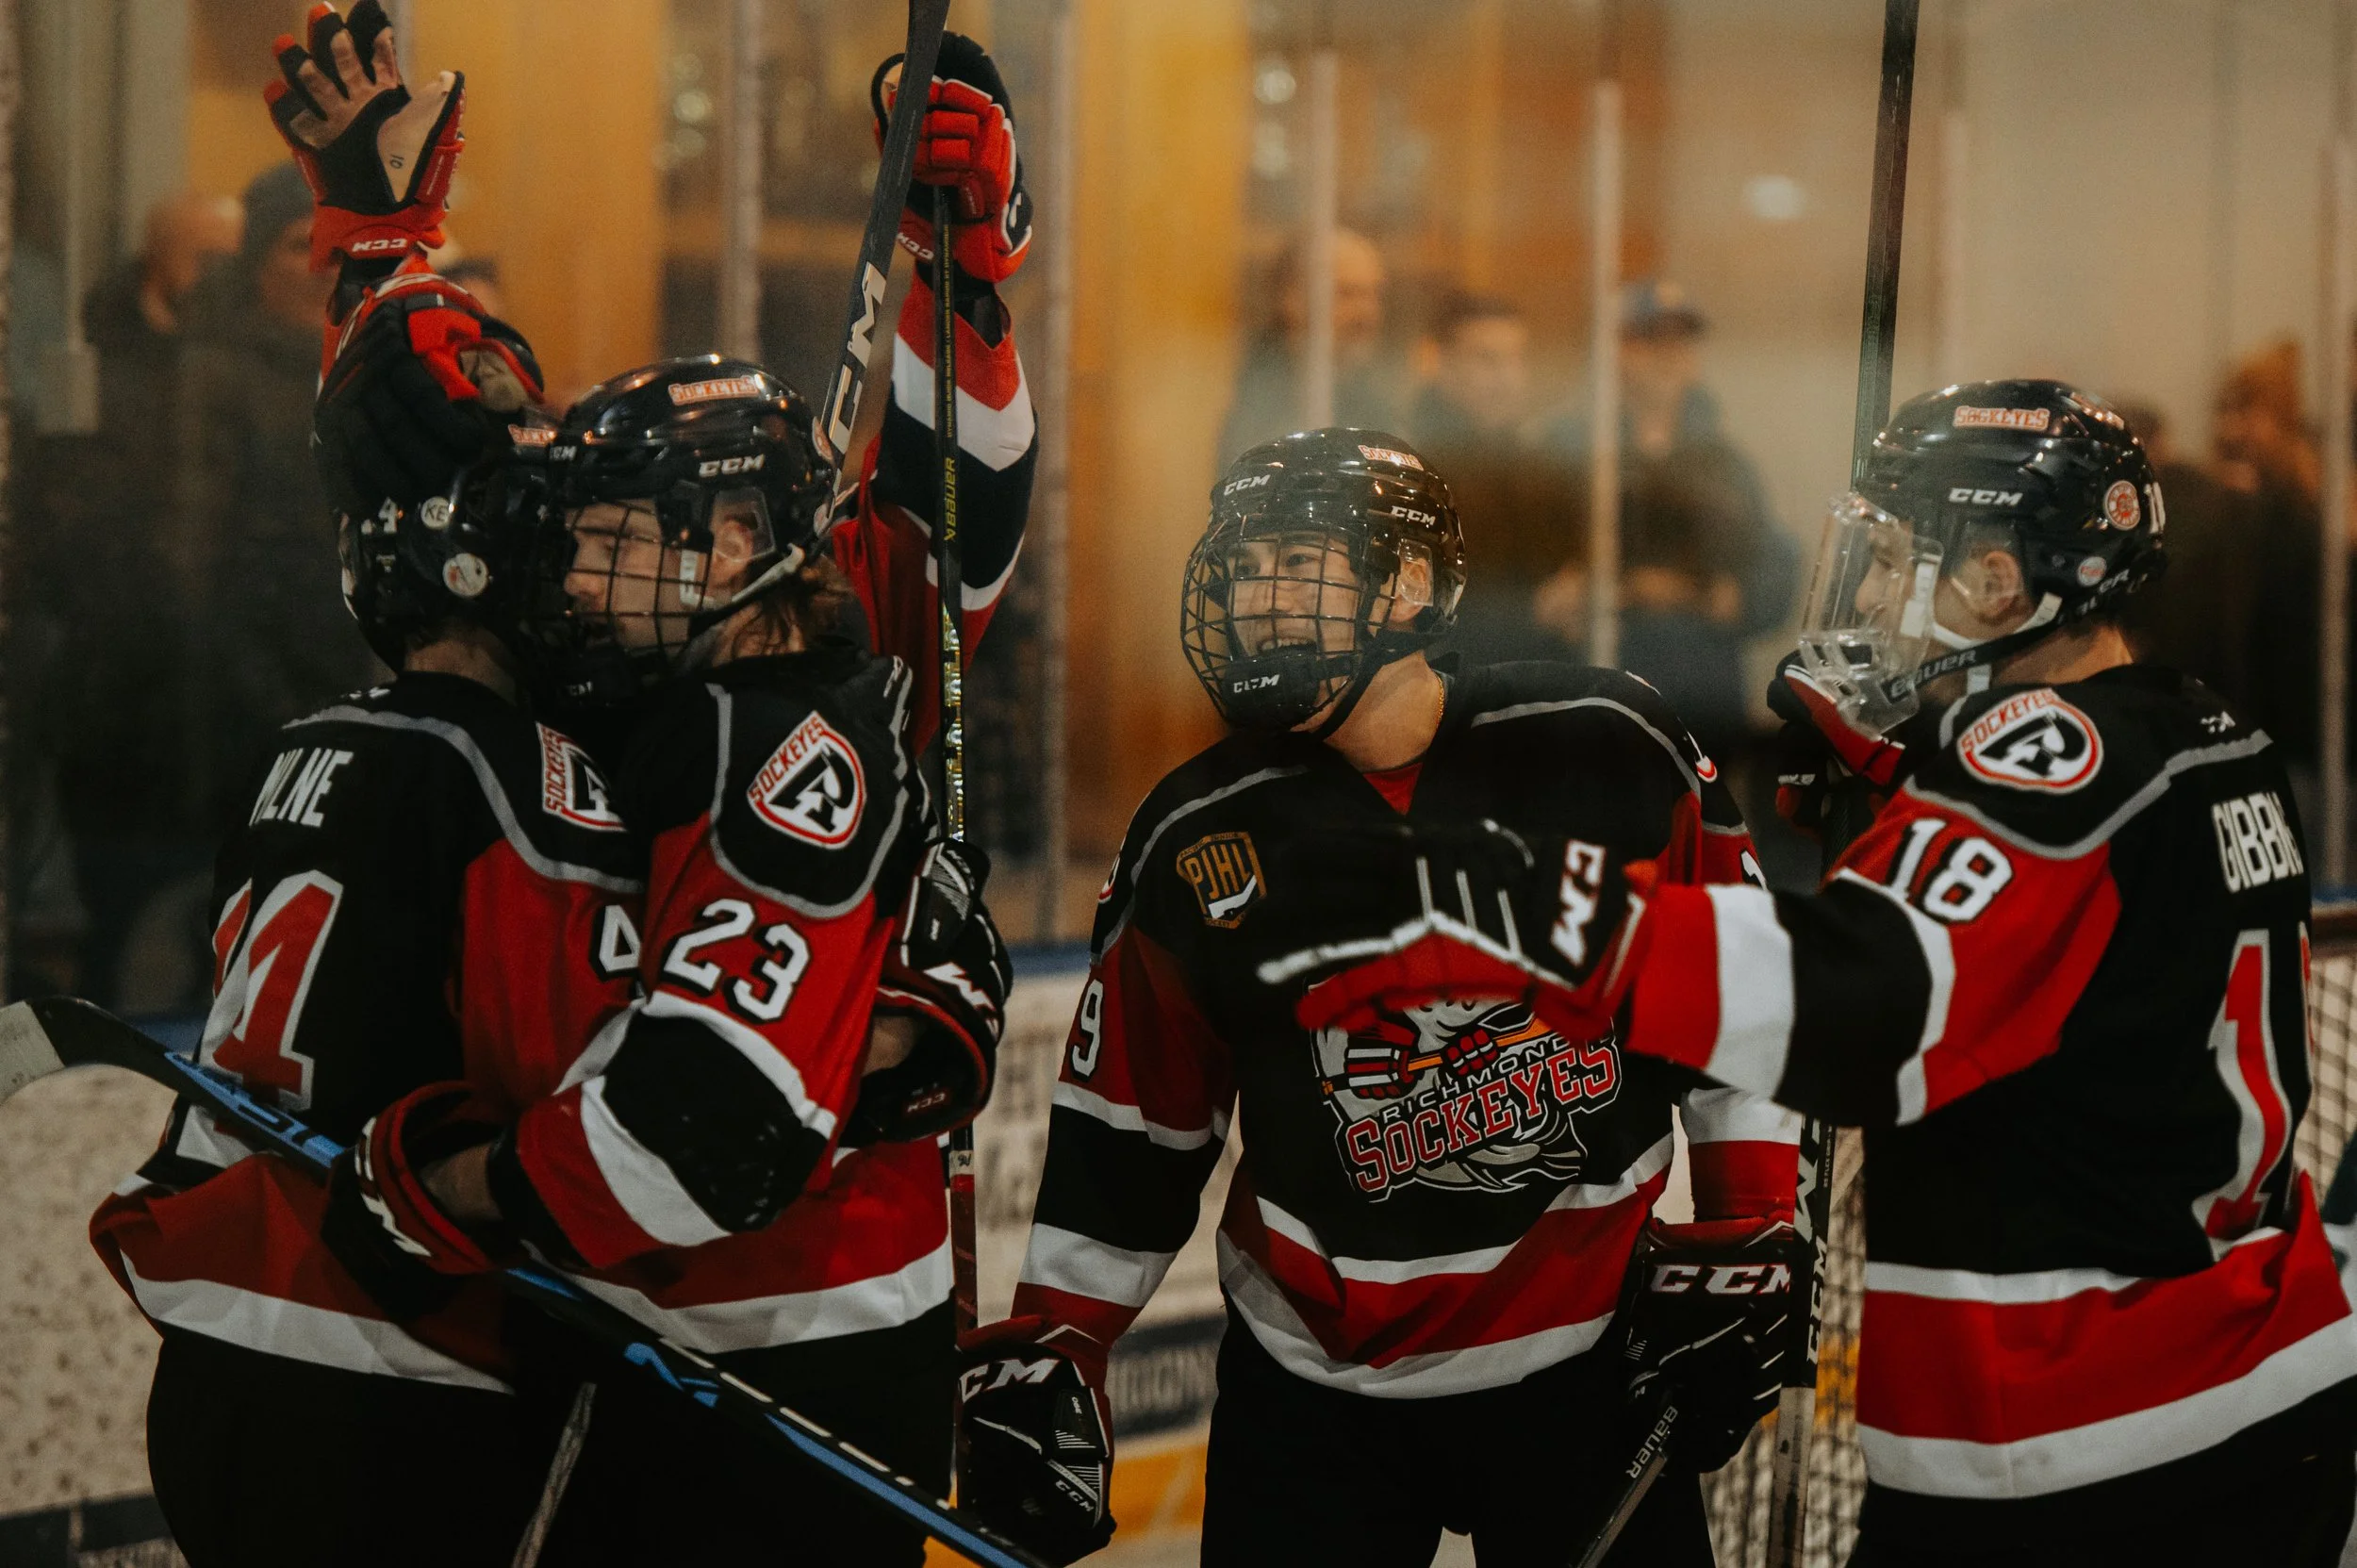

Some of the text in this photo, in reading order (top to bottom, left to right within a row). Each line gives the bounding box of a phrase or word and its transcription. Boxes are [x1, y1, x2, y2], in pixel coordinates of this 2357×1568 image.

[352, 239, 408, 253] CCM
[670, 377, 760, 405] SOCKEYES
[1954, 405, 2050, 431] SOCKEYES
[699, 454, 766, 478] CCM
[944, 457, 956, 527] BAUER
[1224, 475, 1271, 496] CCM
[1949, 487, 2023, 506] CCM
[1391, 505, 1437, 526] CCM
[1961, 688, 2059, 754] SOCKEYES
[544, 726, 568, 813] SOCKEYES
[749, 715, 826, 803] SOCKEYES
[1184, 844, 1251, 900] PJHL
[1887, 817, 2014, 923] 18
[662, 900, 811, 1024] 23
[1345, 1045, 1618, 1193] SOCKEYES
[1806, 1234, 1829, 1365] CCM
[1624, 1406, 1679, 1479] BAUER
[1055, 1479, 1094, 1512] CCM
